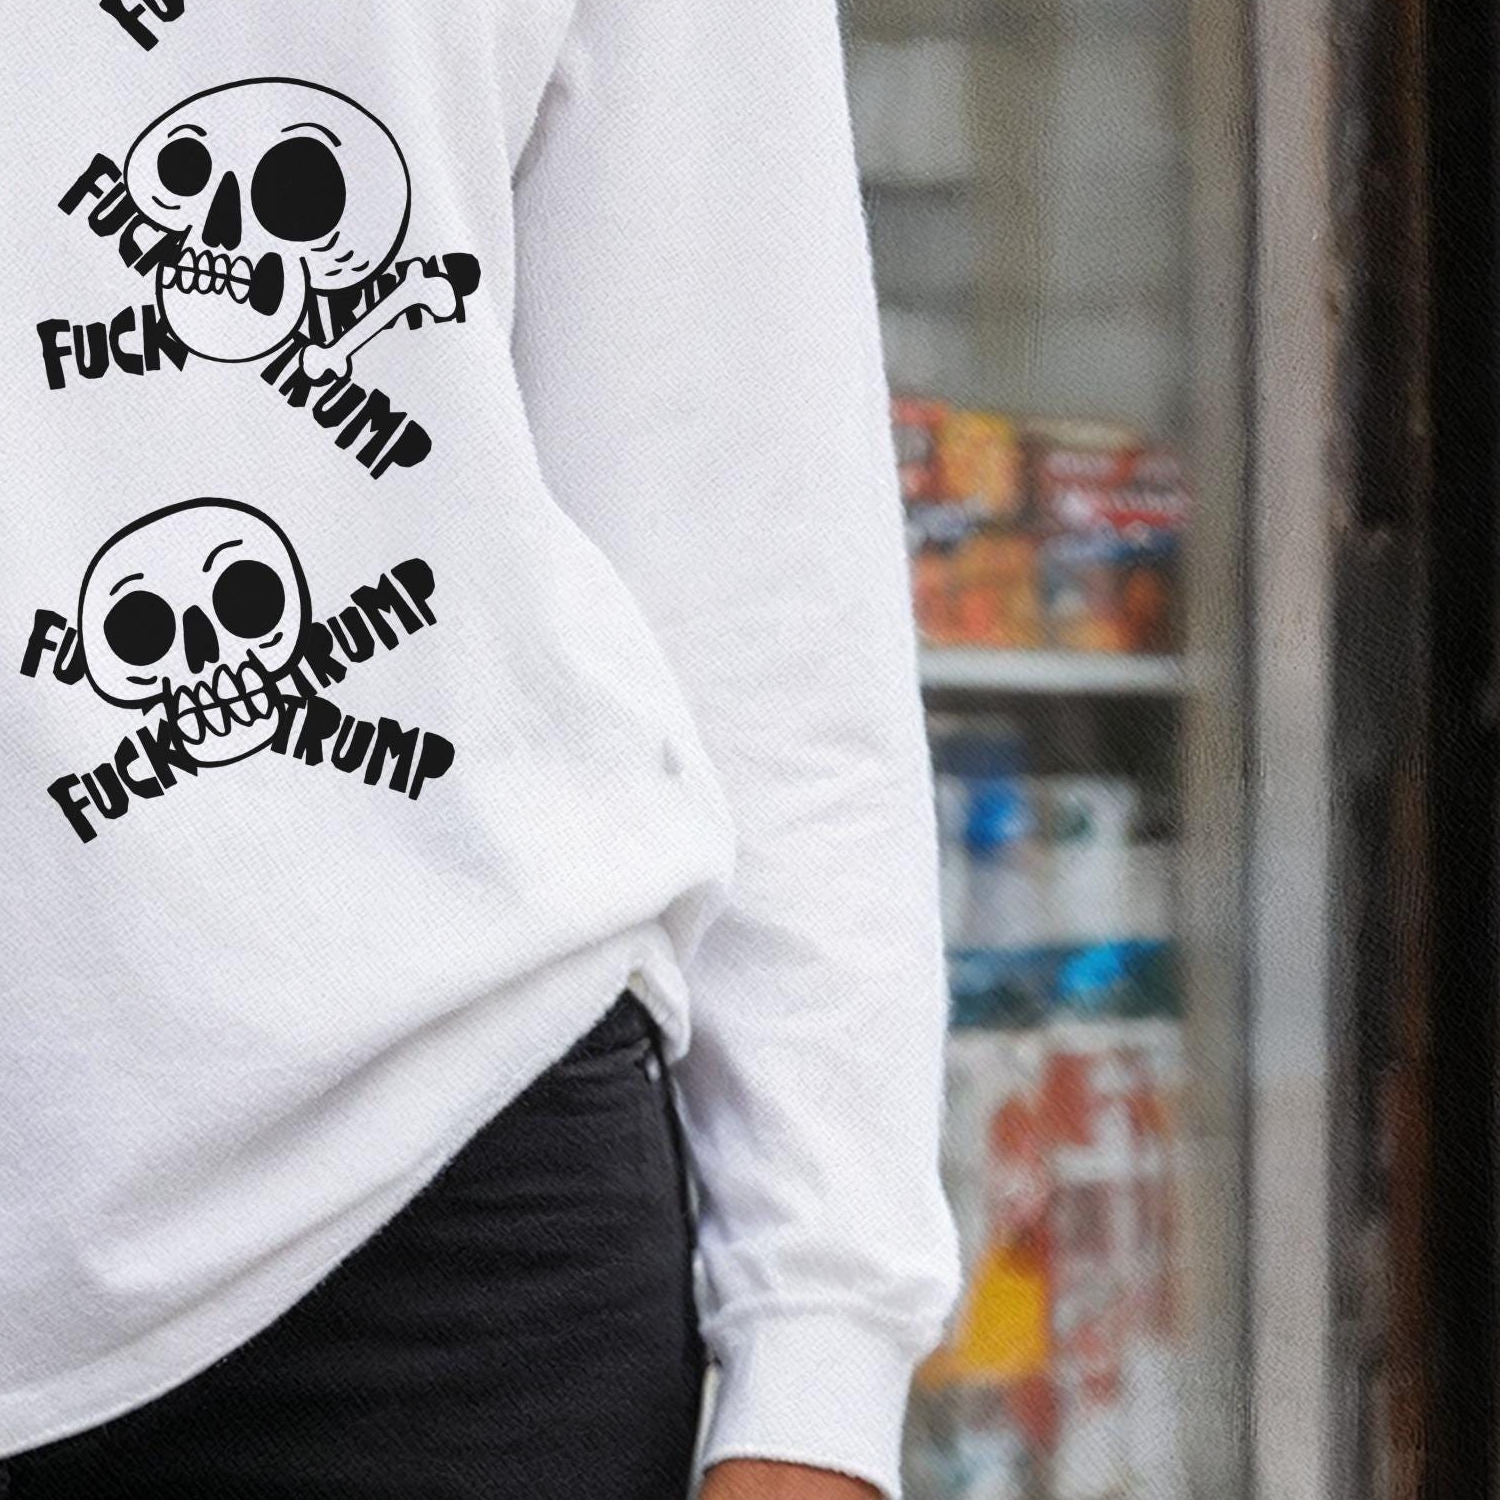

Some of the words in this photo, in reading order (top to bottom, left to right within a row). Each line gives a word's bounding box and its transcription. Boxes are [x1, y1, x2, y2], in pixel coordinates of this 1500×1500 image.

[36, 304, 190, 390] FUCK
[19, 608, 86, 686] FU
[46, 717, 199, 844] FUCK
